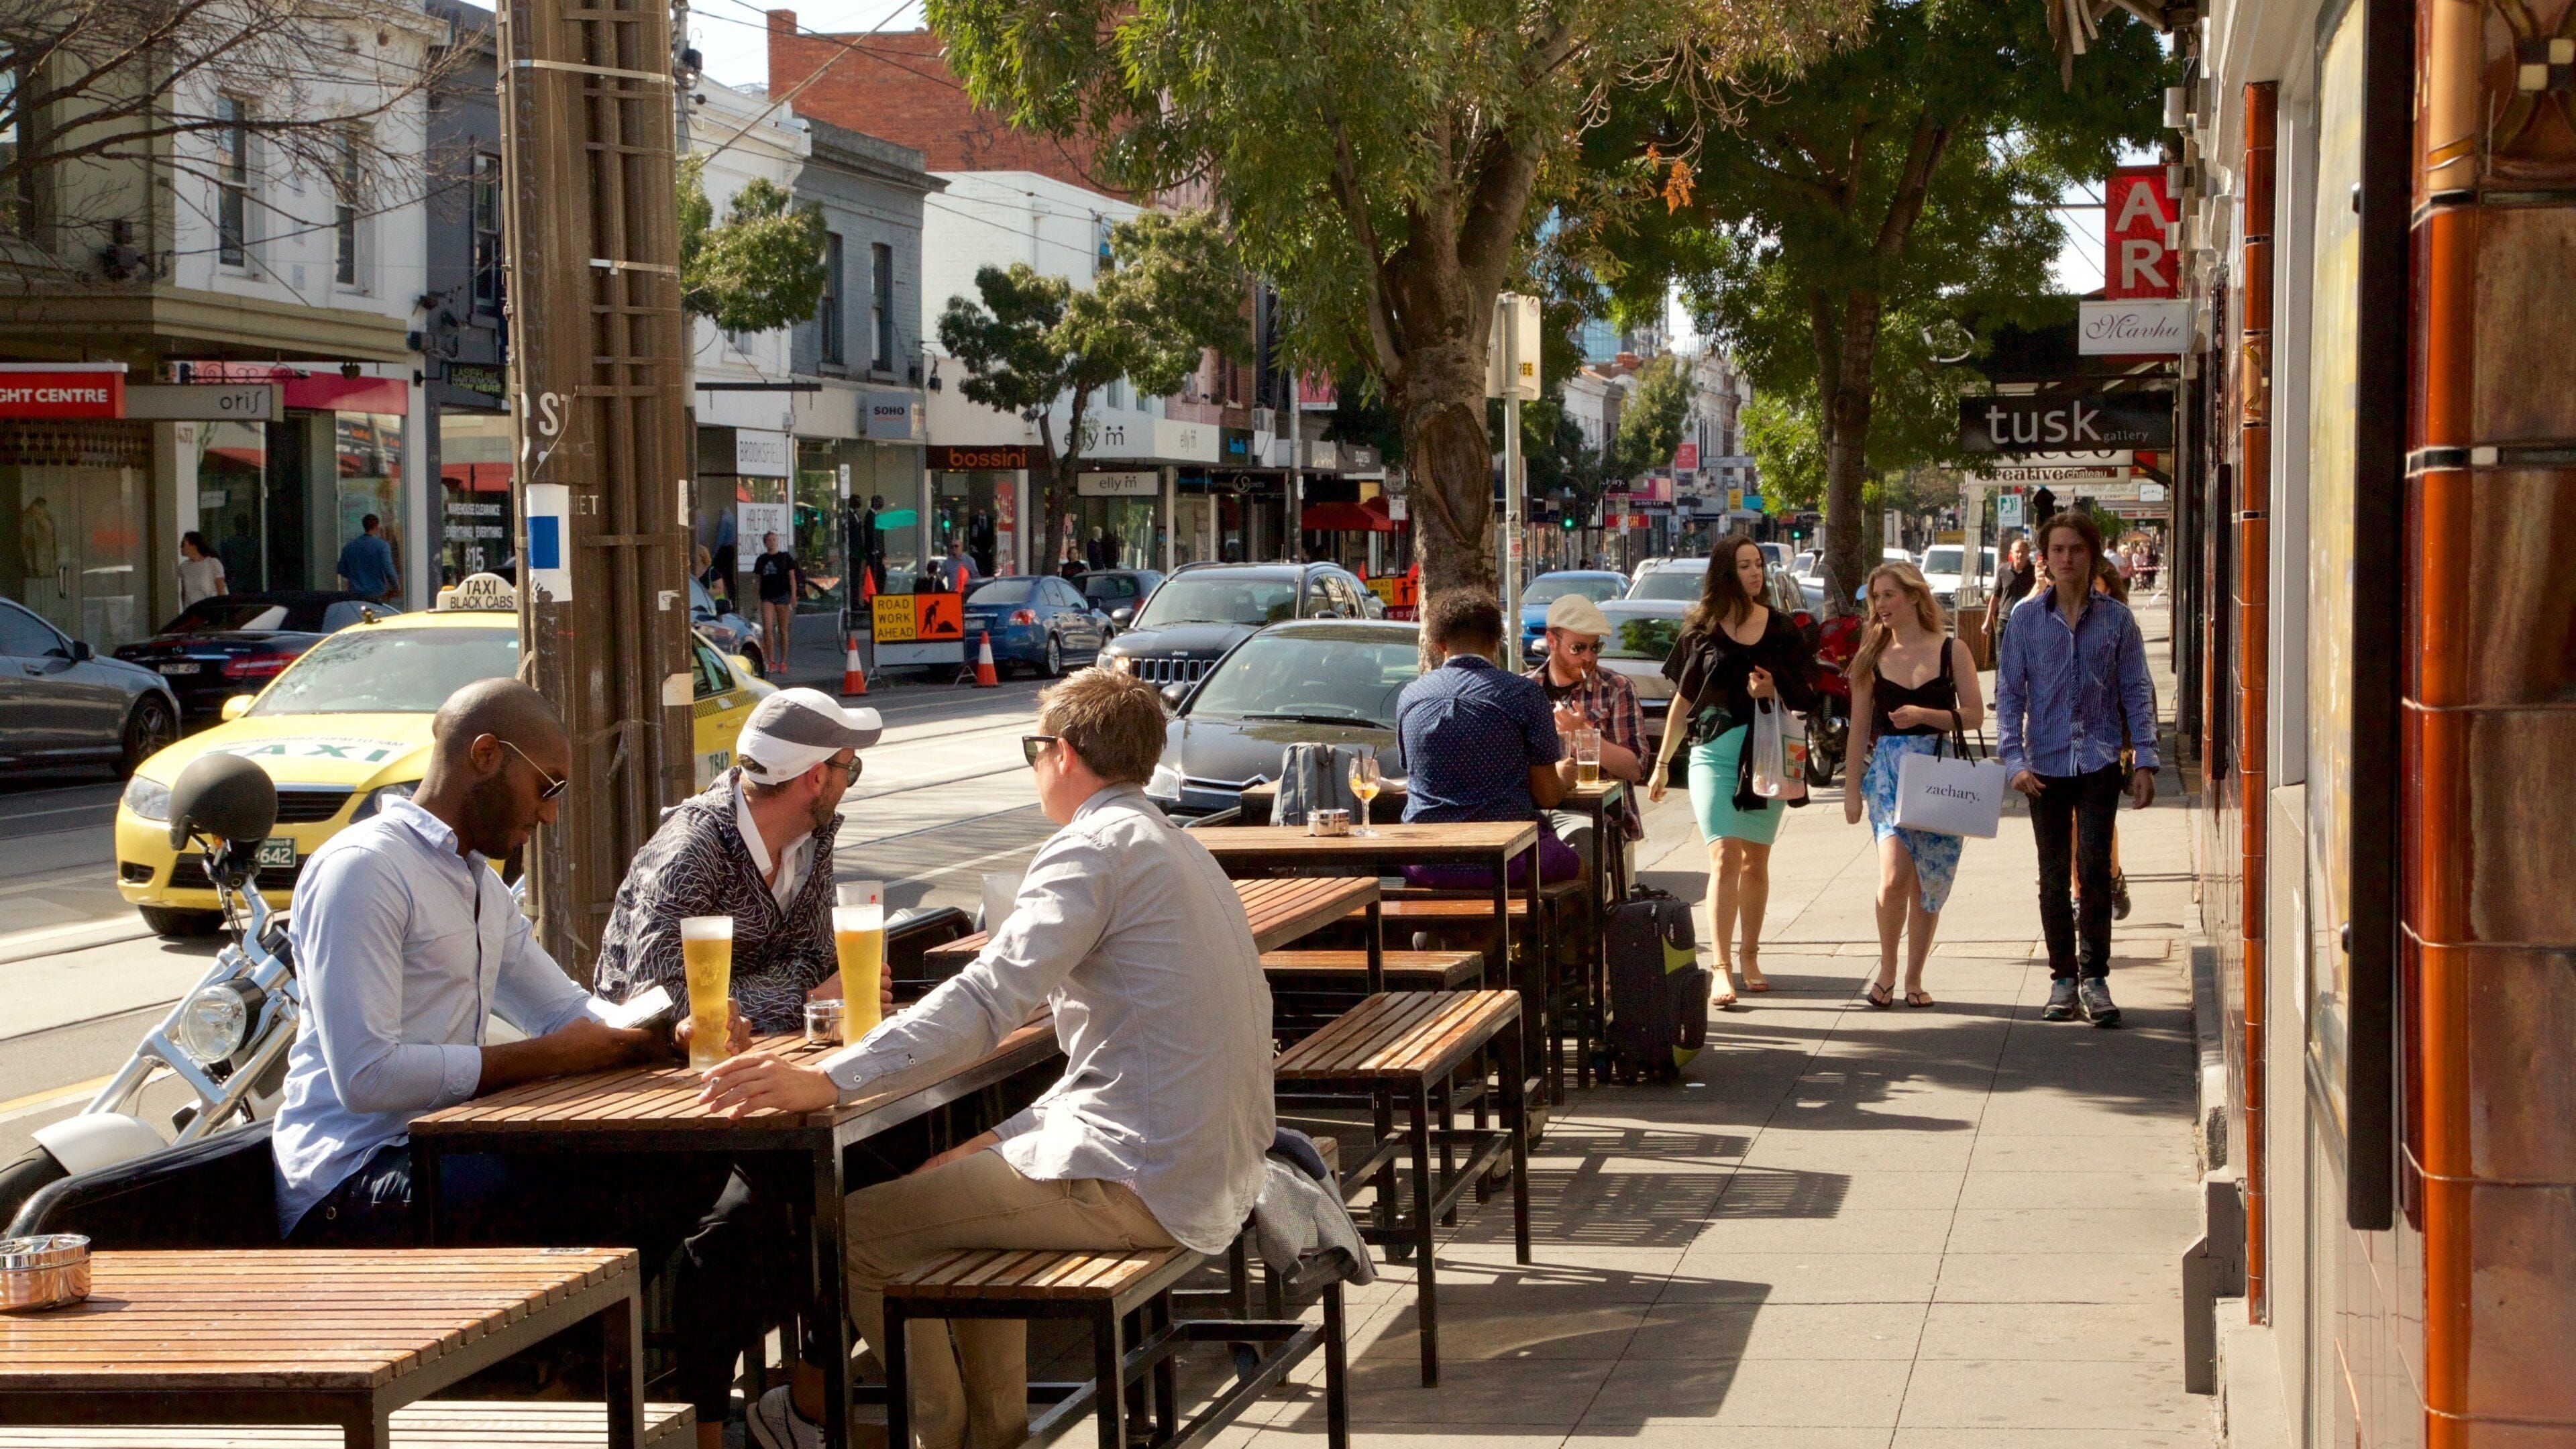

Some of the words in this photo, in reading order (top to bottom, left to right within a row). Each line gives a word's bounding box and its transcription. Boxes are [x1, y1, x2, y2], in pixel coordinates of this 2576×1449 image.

[2114, 181, 2170, 300] AR
[35, 388, 107, 403] CENTRE
[874, 407, 904, 416] SOHO
[1985, 400, 2102, 444] tusk
[2103, 431, 2149, 443] gallery
[949, 447, 1026, 467] bossini
[2067, 468, 2107, 478] chateau
[1099, 476, 1121, 491] elly
[466, 580, 496, 595] TAXI
[450, 596, 482, 608] BLACK
[486, 595, 513, 608] CABS
[878, 599, 910, 610] ROAD
[878, 613, 910, 623] WORK
[877, 627, 914, 637] AHEAD
[1926, 784, 1980, 804] zachary.
